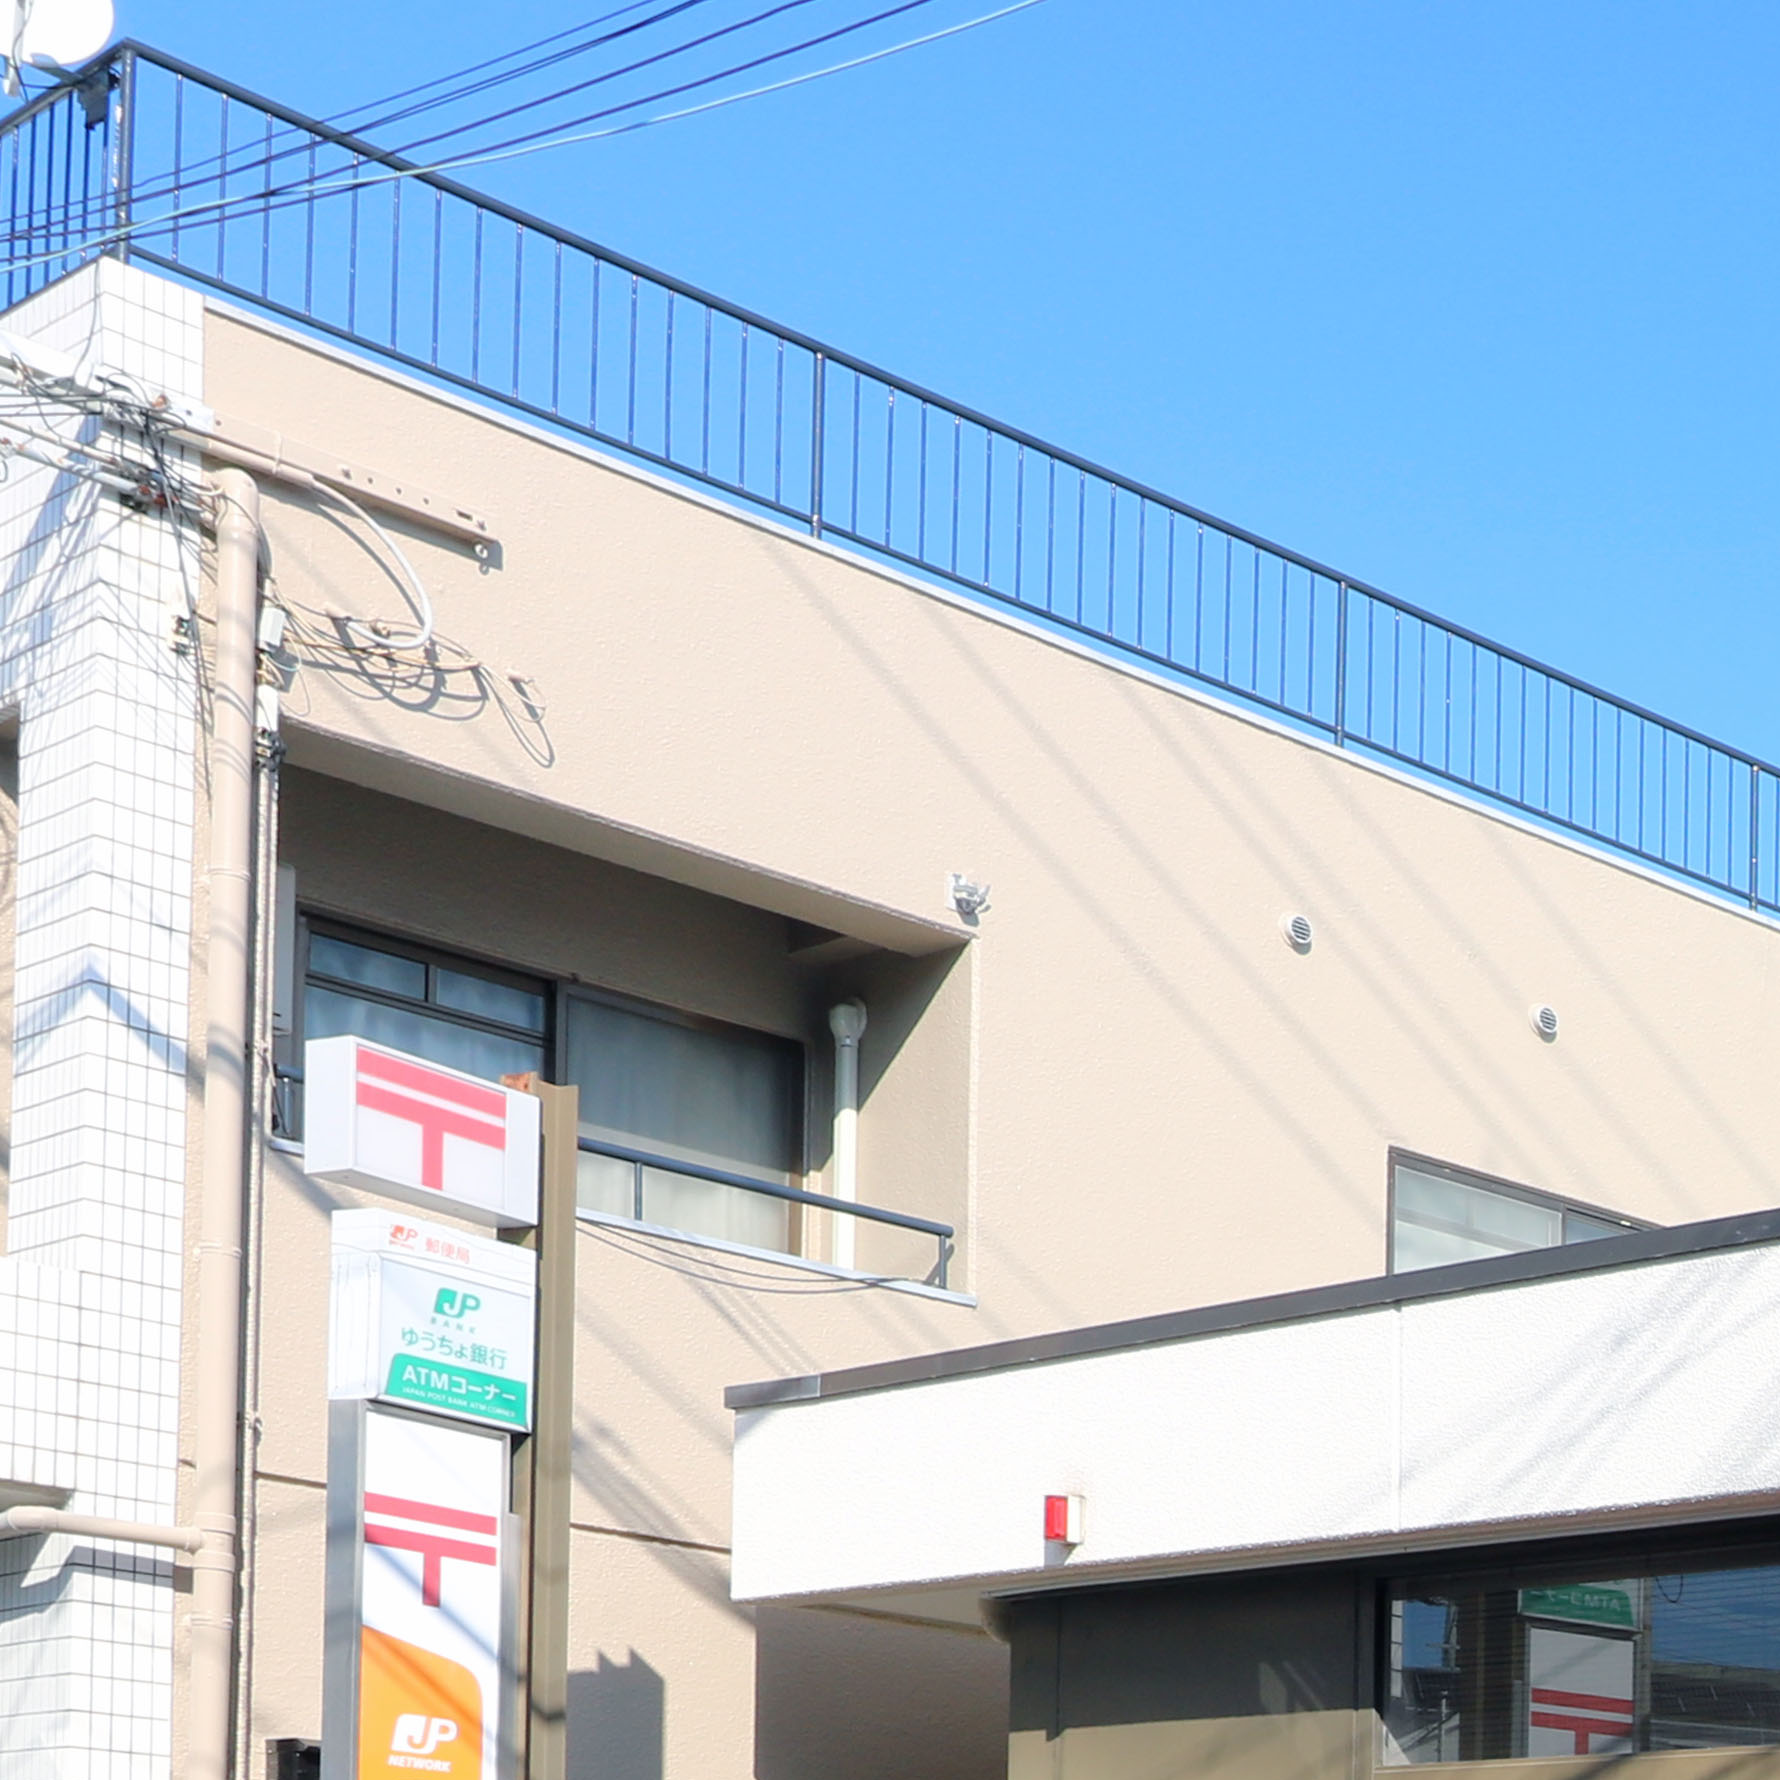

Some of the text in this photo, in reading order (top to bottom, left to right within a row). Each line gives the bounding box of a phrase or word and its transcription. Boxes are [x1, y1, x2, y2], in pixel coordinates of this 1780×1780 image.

[425, 1237, 471, 1264] 郵便局
[433, 1287, 481, 1319] JP
[401, 1327, 508, 1370] ゆうちょ銀行
[402, 1364, 517, 1401] ATMコーナー
[390, 1713, 458, 1756] JP
[387, 1754, 452, 1773] NETWORK
